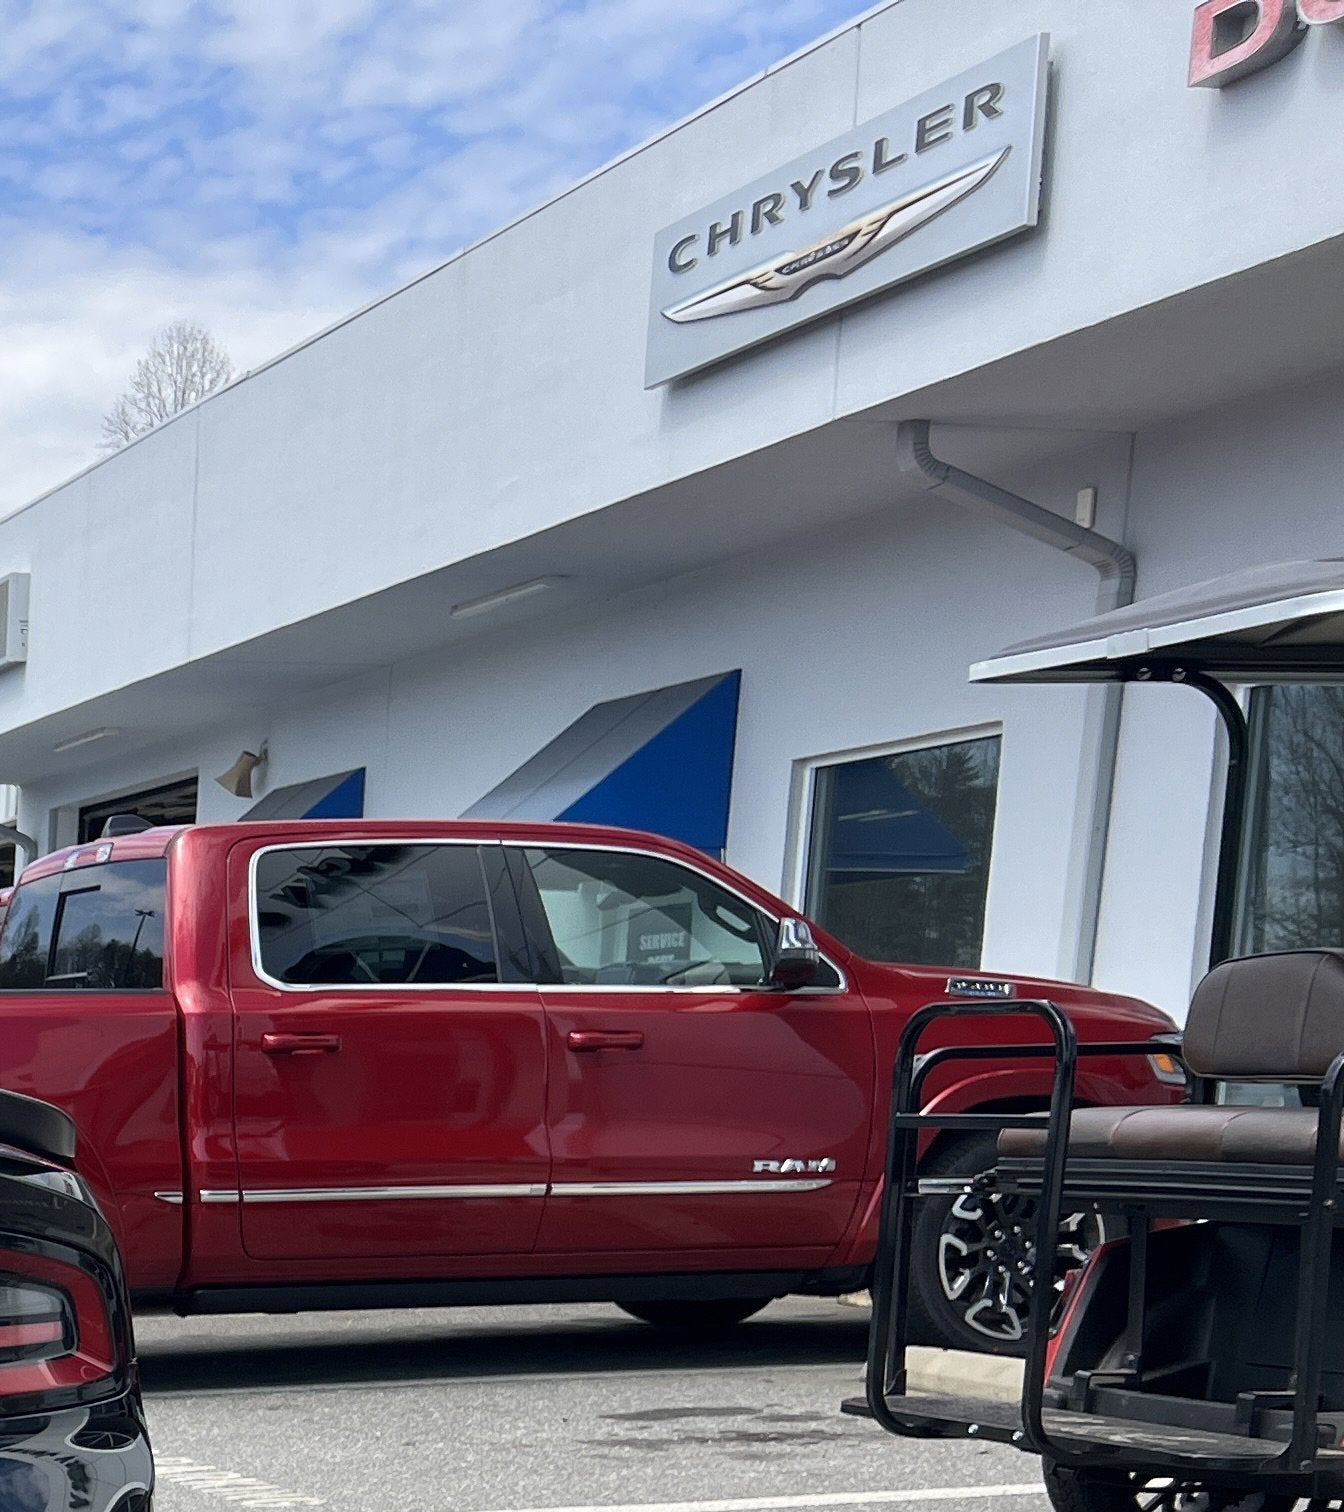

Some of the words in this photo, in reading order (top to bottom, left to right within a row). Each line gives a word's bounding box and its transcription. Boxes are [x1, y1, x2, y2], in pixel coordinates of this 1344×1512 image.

[1188, 0, 1344, 86] D
[668, 81, 1005, 275] CHRYSLER
[639, 931, 686, 951] SERVICE
[752, 1157, 837, 1172] RAM
